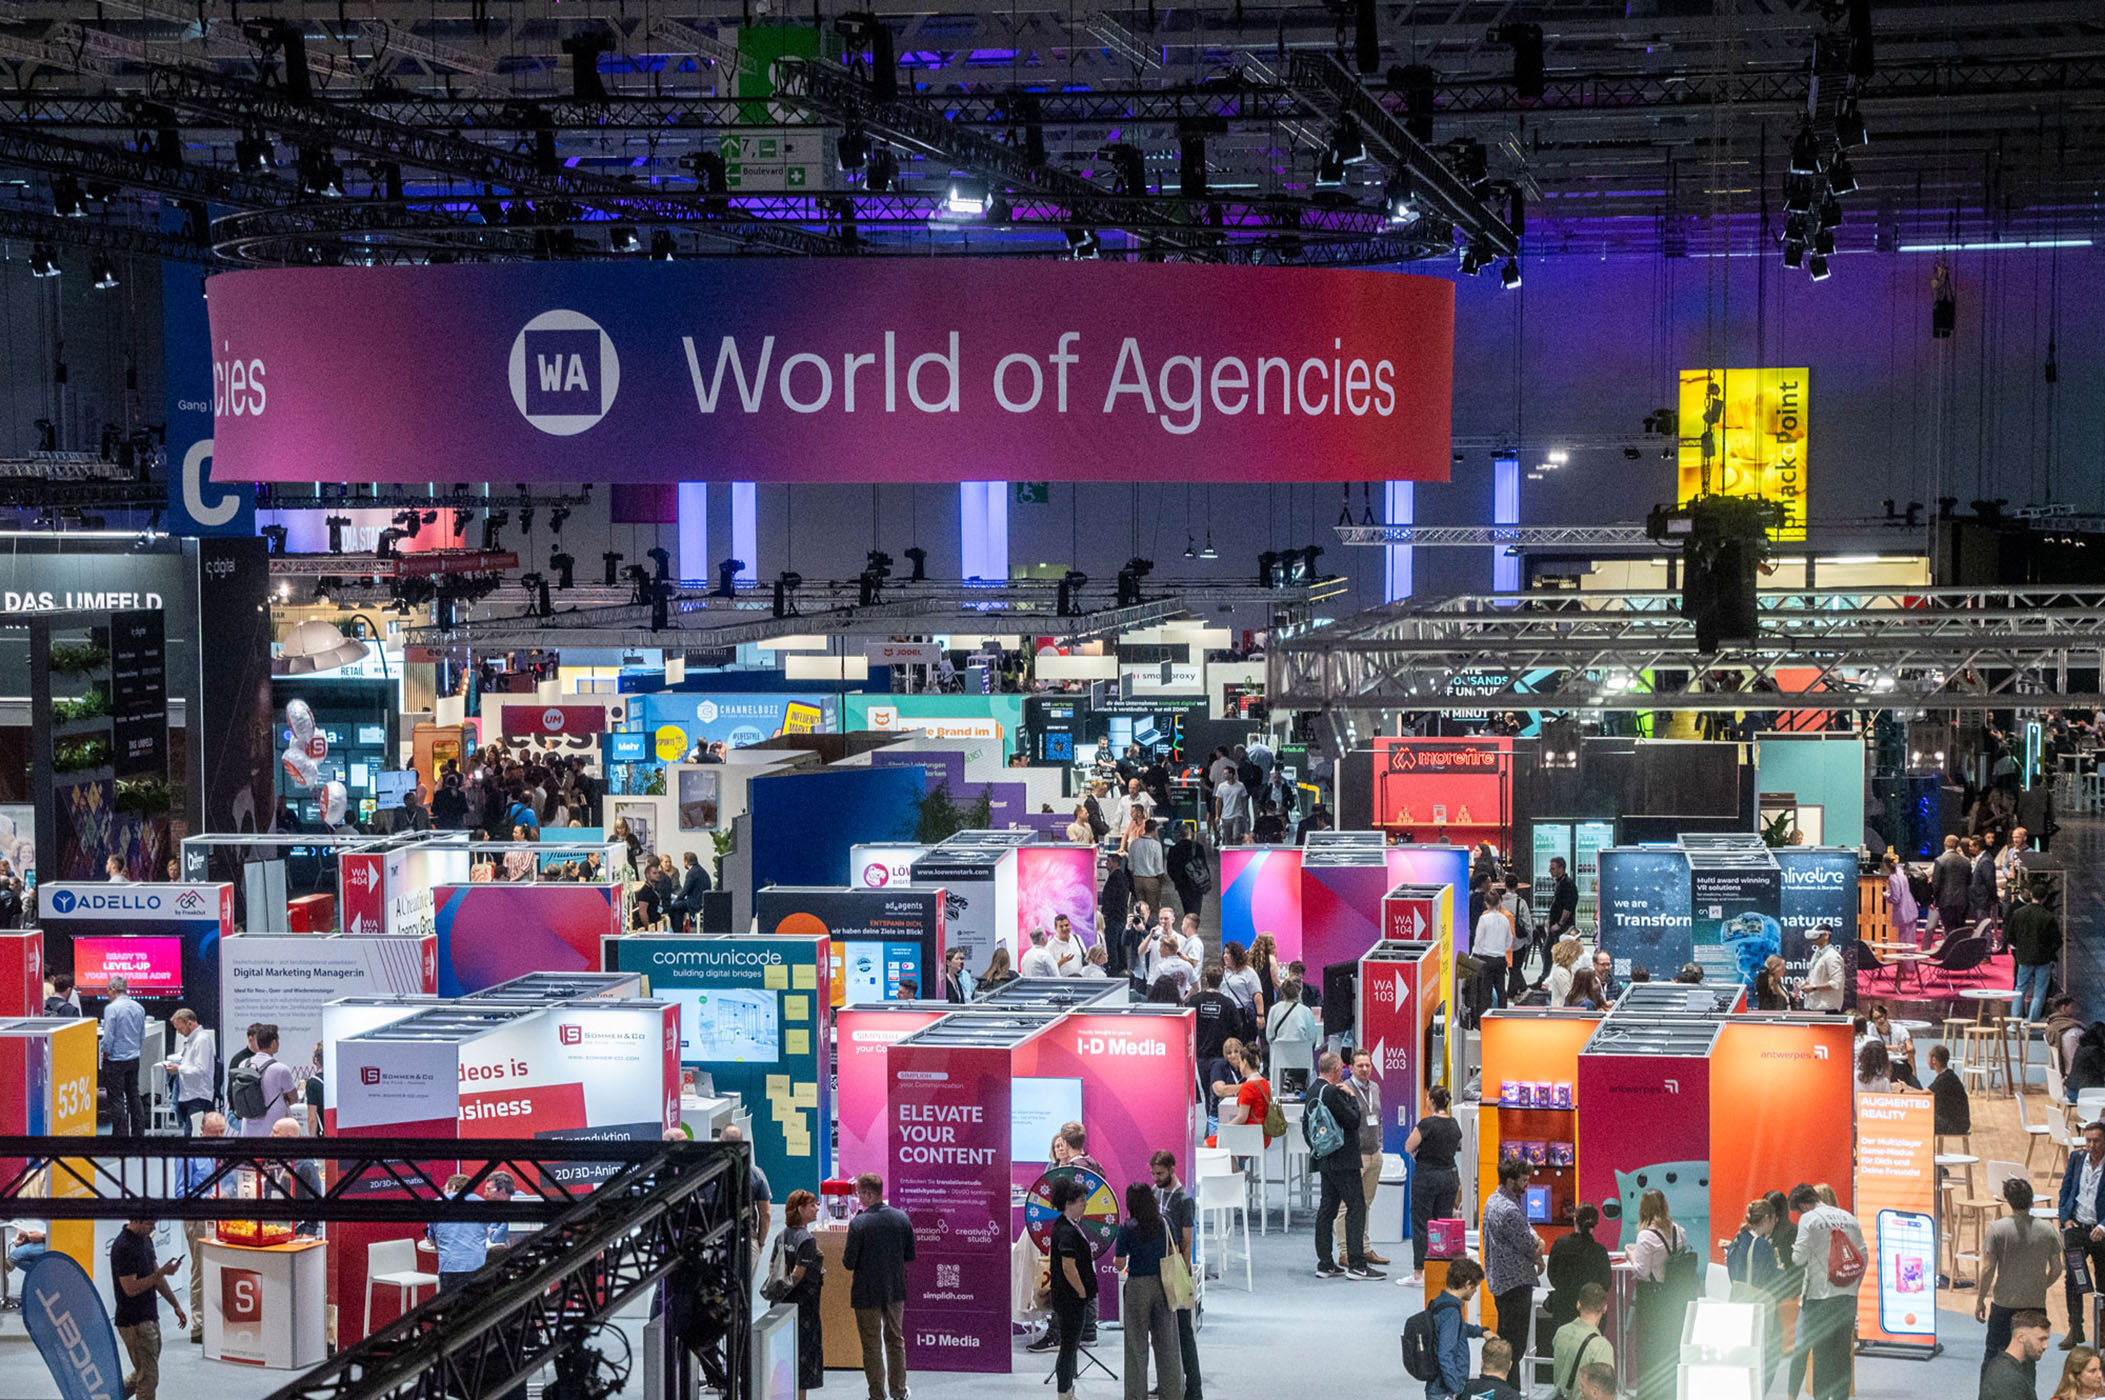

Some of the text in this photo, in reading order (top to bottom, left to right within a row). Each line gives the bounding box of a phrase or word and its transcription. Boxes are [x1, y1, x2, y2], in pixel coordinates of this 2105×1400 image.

[742, 167, 784, 175] Boulevard
[537, 353, 590, 392] WA
[682, 331, 1397, 436] World of Agencies
[177, 400, 207, 412] Gang
[1776, 381, 1799, 444] Point
[182, 439, 241, 527] C
[4, 592, 54, 610] DAS
[340, 664, 364, 676] RETAIL
[720, 704, 779, 714] CHANNELBUZZ
[545, 715, 561, 724] UM
[937, 727, 989, 737] Brand im
[618, 742, 640, 751] Mehr
[1418, 748, 1495, 766] morefire
[352, 868, 368, 877] WA
[352, 877, 368, 886] 404
[1696, 877, 1771, 887] Multi award winning
[77, 895, 161, 909] ADELLO
[396, 898, 402, 917] A
[362, 919, 378, 928] WA
[1394, 916, 1413, 925] WA
[1394, 925, 1413, 934] 104
[653, 949, 782, 966] communicode
[103, 962, 151, 970] LEVEL-UP
[233, 967, 365, 979] Digital Marketing Manager:in
[673, 969, 762, 979] building digital bridges
[1373, 980, 1394, 990] WA
[1374, 992, 1394, 1001] 103
[855, 1045, 875, 1054] your
[1078, 1038, 1167, 1056] I-D Media
[1386, 1048, 1407, 1058] WA
[1761, 1051, 1812, 1060] antwerpes
[510, 1058, 529, 1077] is
[1385, 1059, 1407, 1070] 203
[1608, 1084, 1661, 1095] antwerpes
[58, 1076, 92, 1120] 53%
[1861, 1096, 1931, 1109] AUGMENTED
[900, 1105, 984, 1123] ELEVATE
[1861, 1109, 1906, 1120] REALITY
[899, 1125, 956, 1143] YOUR
[899, 1146, 996, 1165] CONTENT
[955, 1227, 992, 1237] creativity
[235, 1280, 254, 1313] S
[923, 1291, 974, 1301] simplidh.com
[916, 1333, 980, 1347] I-D Media
